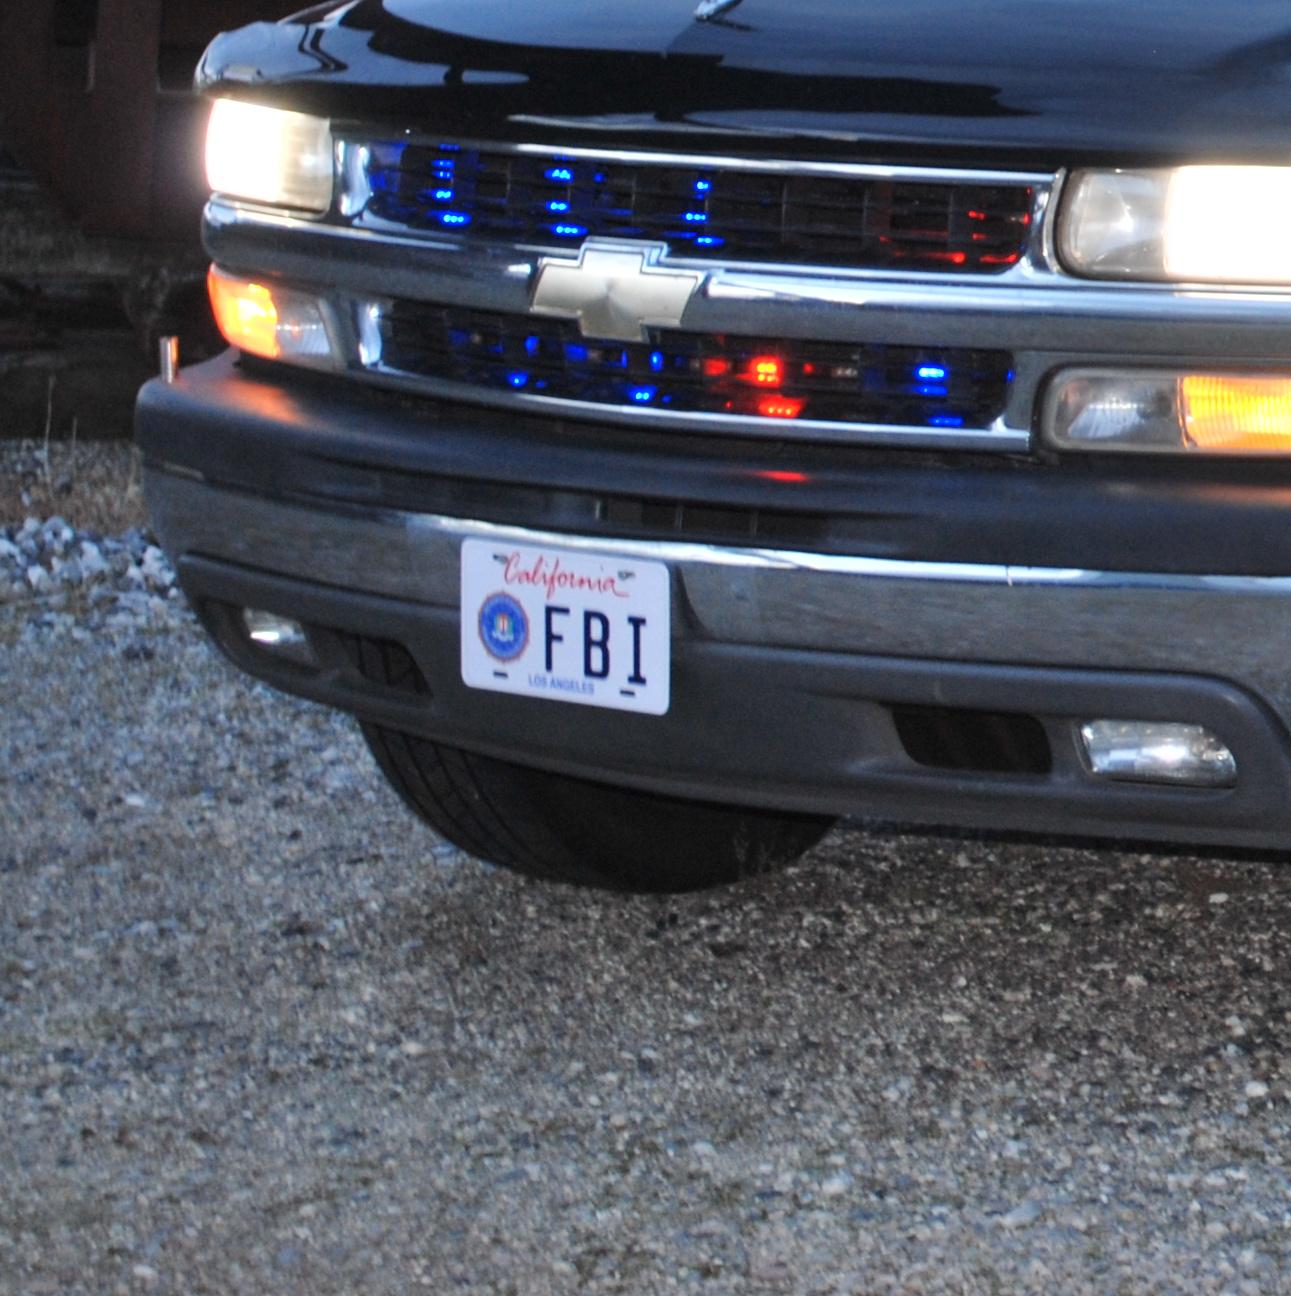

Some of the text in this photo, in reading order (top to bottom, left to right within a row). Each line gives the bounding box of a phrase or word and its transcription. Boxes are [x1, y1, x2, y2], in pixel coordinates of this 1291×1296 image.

[504, 551, 629, 599] California
[545, 605, 647, 685] FBI
[528, 674, 594, 695] LOS ANGELES
